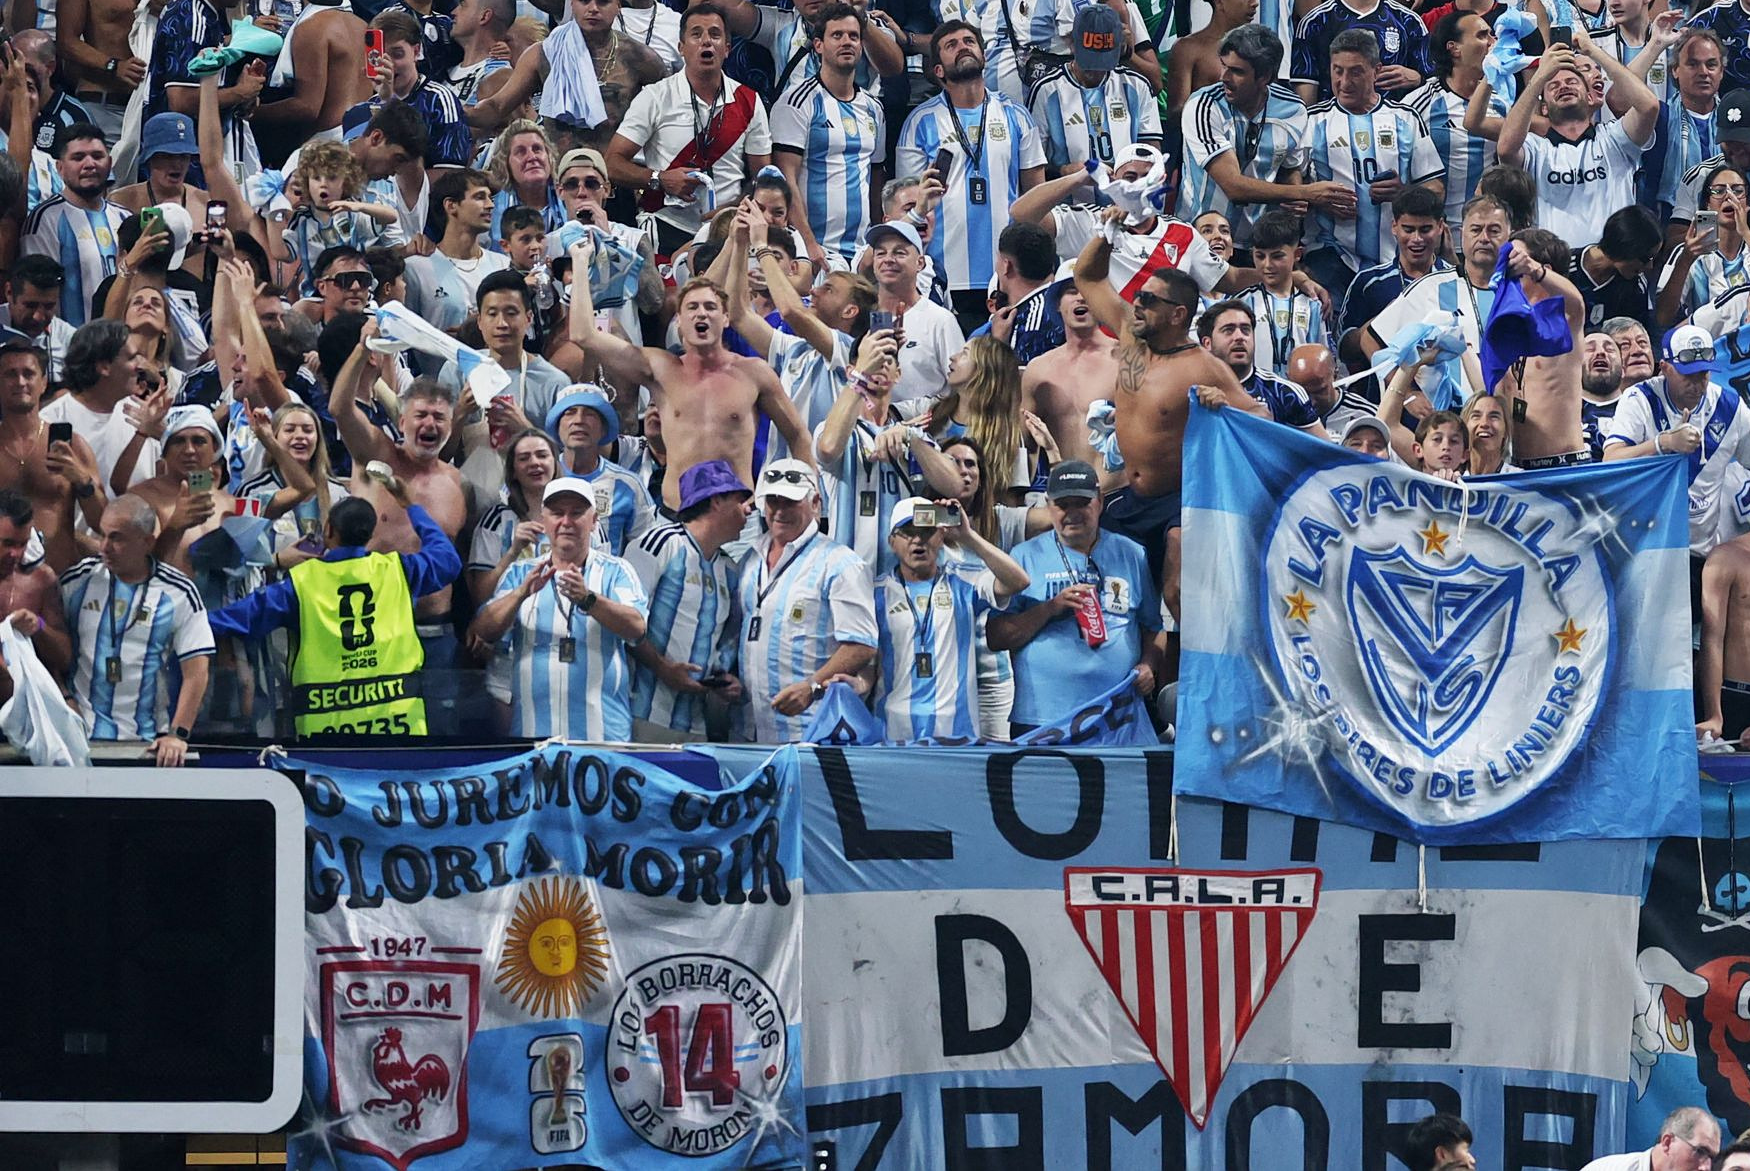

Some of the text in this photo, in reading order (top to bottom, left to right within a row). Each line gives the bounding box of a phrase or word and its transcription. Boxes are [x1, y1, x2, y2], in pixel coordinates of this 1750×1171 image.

[1351, 157, 1378, 185] 10
[1547, 165, 1607, 185] adidas
[1287, 474, 1582, 590] LA PANDILLA
[1427, 767, 1476, 801] DE
[1486, 661, 1582, 786] LINIERS
[371, 749, 647, 830] JUREMOS
[669, 765, 777, 832] CON
[304, 825, 554, 914] GLORIA
[1091, 875, 1304, 906] C.A.L.A.
[370, 936, 427, 958] 1947
[345, 981, 452, 1009] C.D.M
[641, 962, 780, 1050] BORRACHOS
[934, 913, 1457, 1058] D E
[643, 1002, 741, 1111] 14
[548, 1129, 572, 1143] FIFA
[627, 1099, 754, 1157] DE MORON
